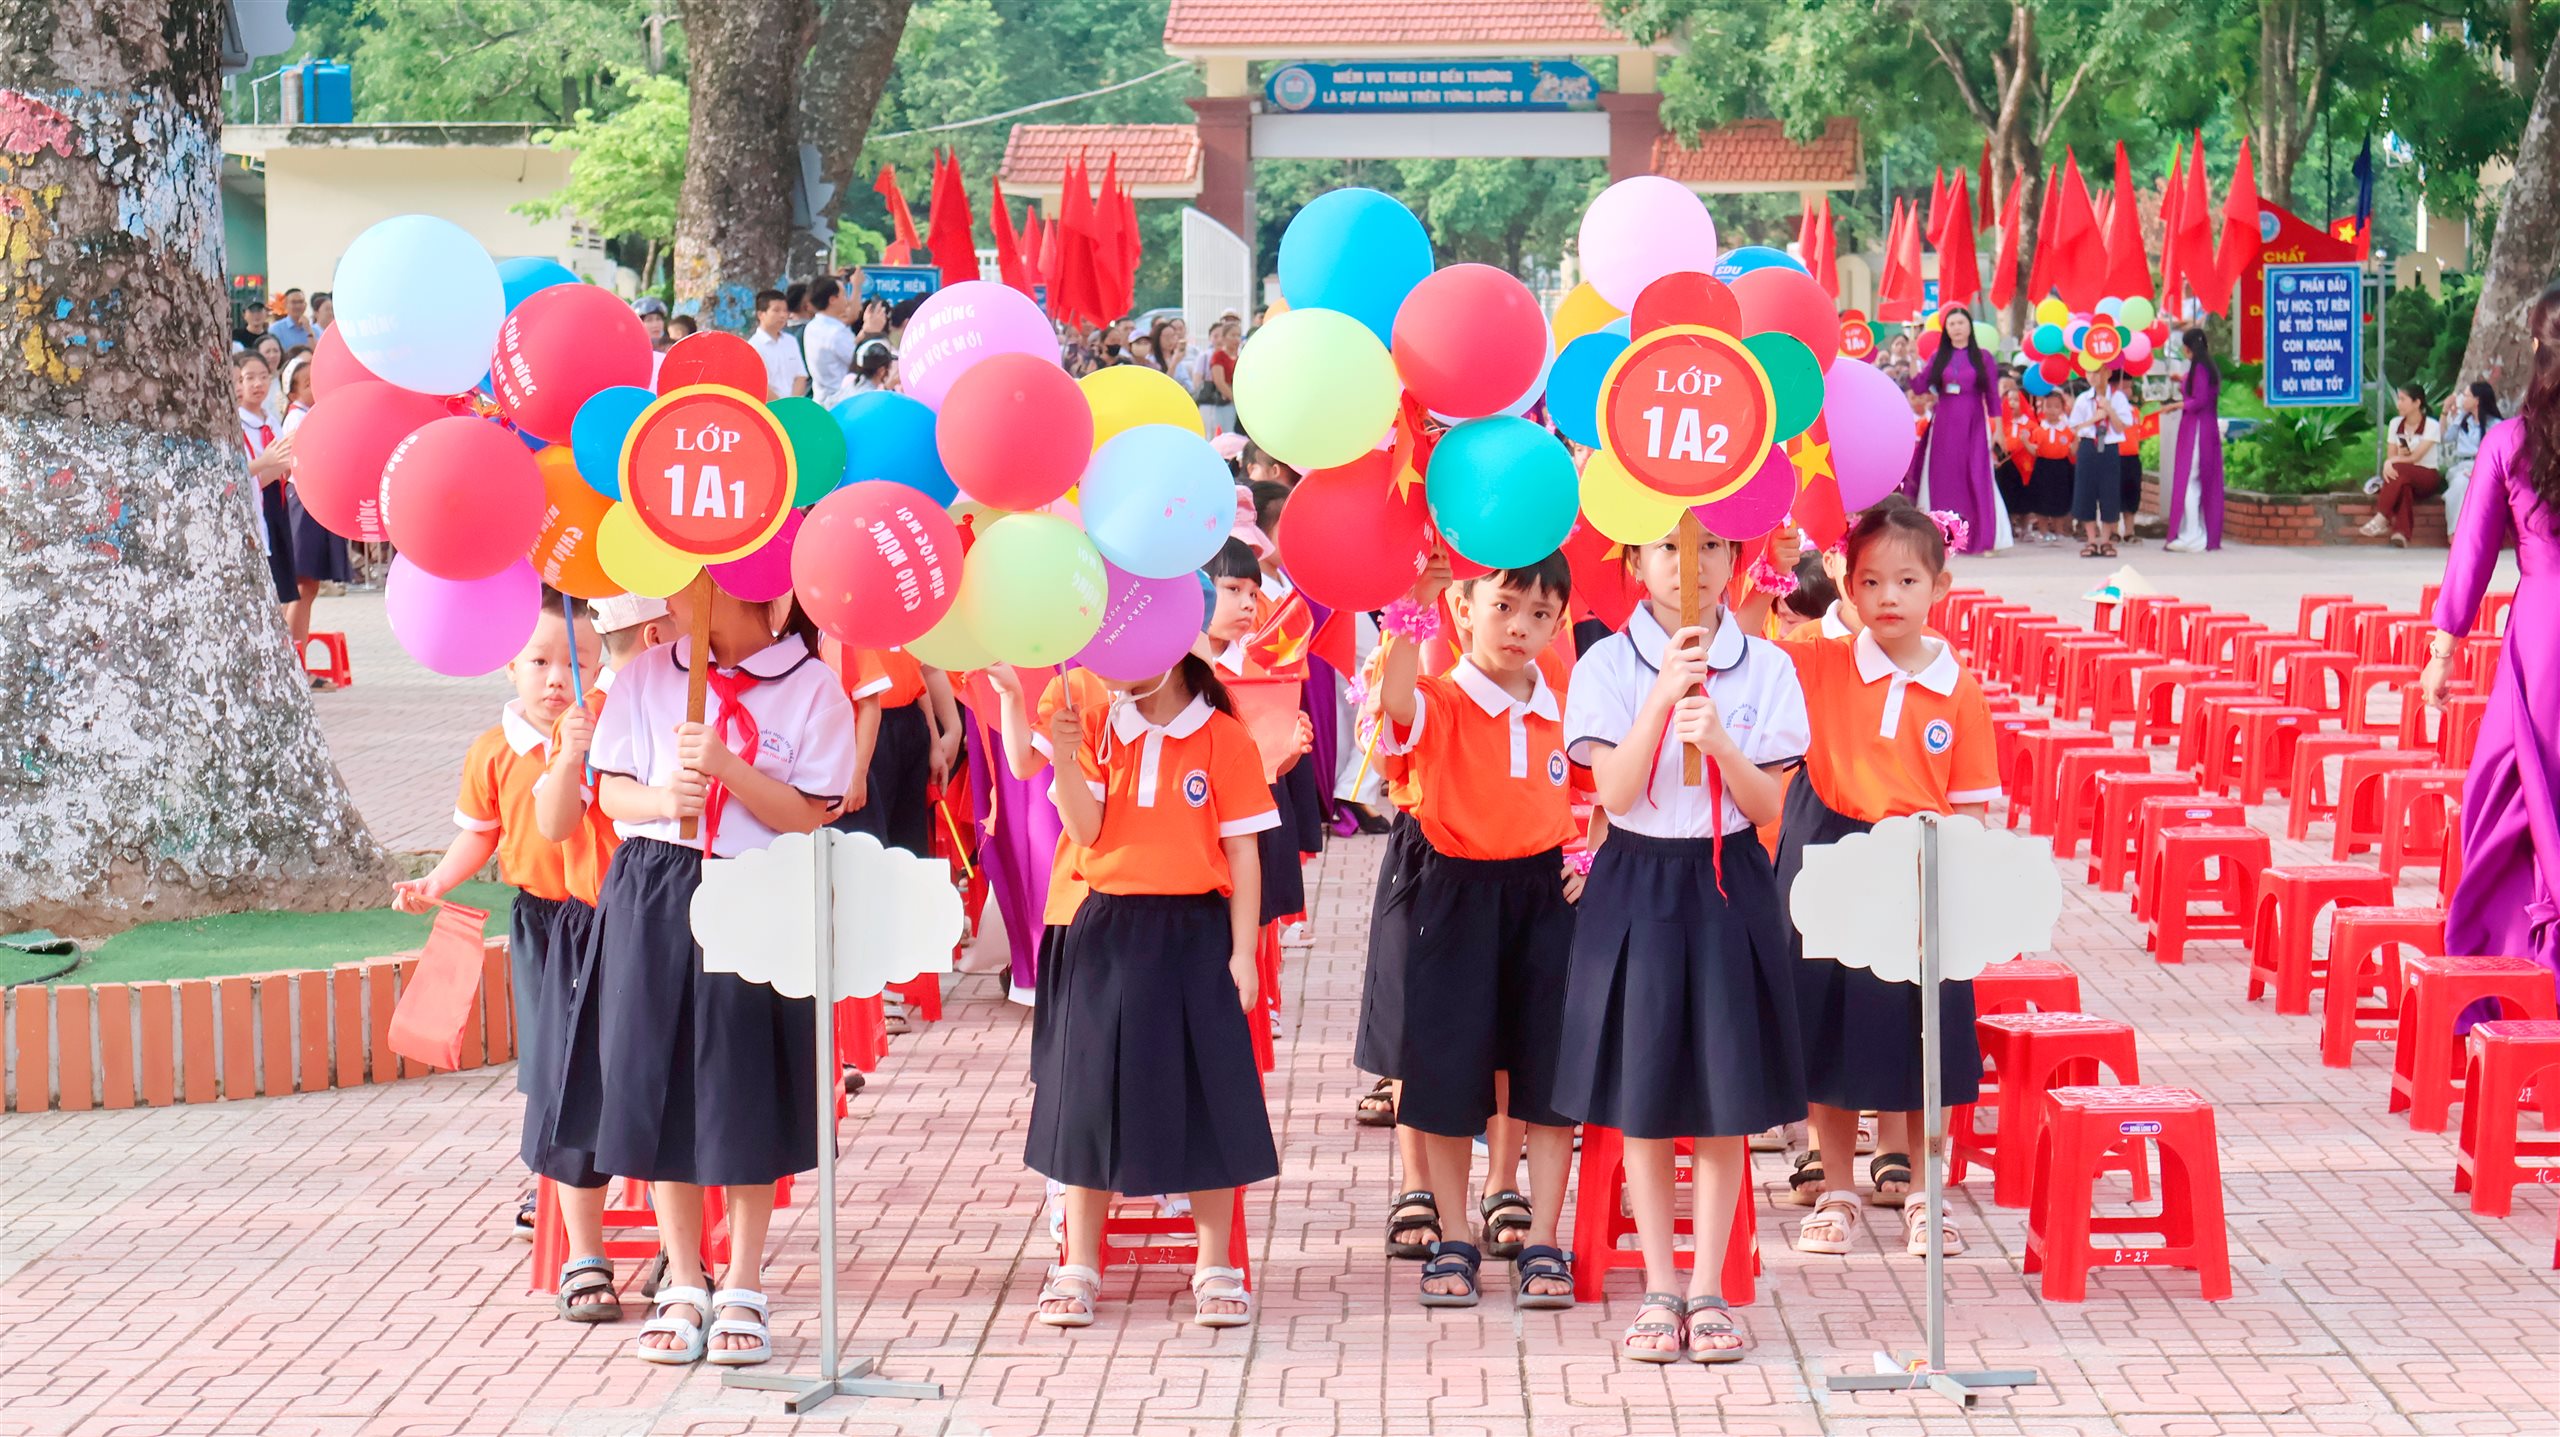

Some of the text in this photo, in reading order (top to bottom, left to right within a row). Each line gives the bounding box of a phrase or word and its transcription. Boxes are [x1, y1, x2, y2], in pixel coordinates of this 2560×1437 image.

[1366, 71, 1386, 84] VUI
[1387, 71, 1417, 84] THEO
[1419, 71, 1438, 84] EM
[1440, 68, 1465, 84] ĐẾN
[1466, 68, 1513, 84] TRƯỜNG
[1322, 87, 1523, 106] LÀ SỰ AN TOÀN TRÊN TỪNG BƯỚC ĐI
[2263, 245, 2306, 262] CHẤT
[1715, 265, 1742, 275] EDU
[2300, 276, 2347, 292] PHẤN ĐẤU
[2276, 298, 2289, 316] TỰ
[2316, 297, 2330, 316] TỰ
[2331, 296, 2350, 312] RÈN
[901, 304, 975, 360] CHÀO MỪNG
[2279, 315, 2347, 333] ĐỂ TRỞ THÀNH
[505, 315, 537, 397] CHÀO MỪNG
[2282, 338, 2343, 353] CON NGOAN,
[907, 331, 983, 389] NĂM HỌC MỚI
[2291, 356, 2311, 372] TRÒ
[1655, 365, 1722, 396] LỚP
[2282, 376, 2344, 394] ĐỘI VIÊN TỐT
[502, 383, 520, 410] MỚI
[674, 422, 741, 452] LỚP
[1642, 405, 1729, 464] 1A2
[387, 434, 419, 473] CHÀO
[664, 464, 745, 519] 1A1
[355, 499, 379, 532] MỪNG
[551, 526, 584, 562] CHÀO
[895, 506, 945, 600] NĂM HỌC MỚI
[868, 520, 921, 612] CHÀO MỪNG
[1122, 580, 1141, 603] NĂM
[1104, 594, 1153, 646] CHÀO MỪNG
[2375, 1029, 2390, 1040] 1C
[2518, 1087, 2532, 1103] 27
[2536, 1168, 2553, 1183] 1C
[1126, 1250, 1138, 1264] A
[1158, 1248, 1176, 1265] 27
[2114, 1250, 2122, 1263] B
[2133, 1251, 2149, 1263] 27
